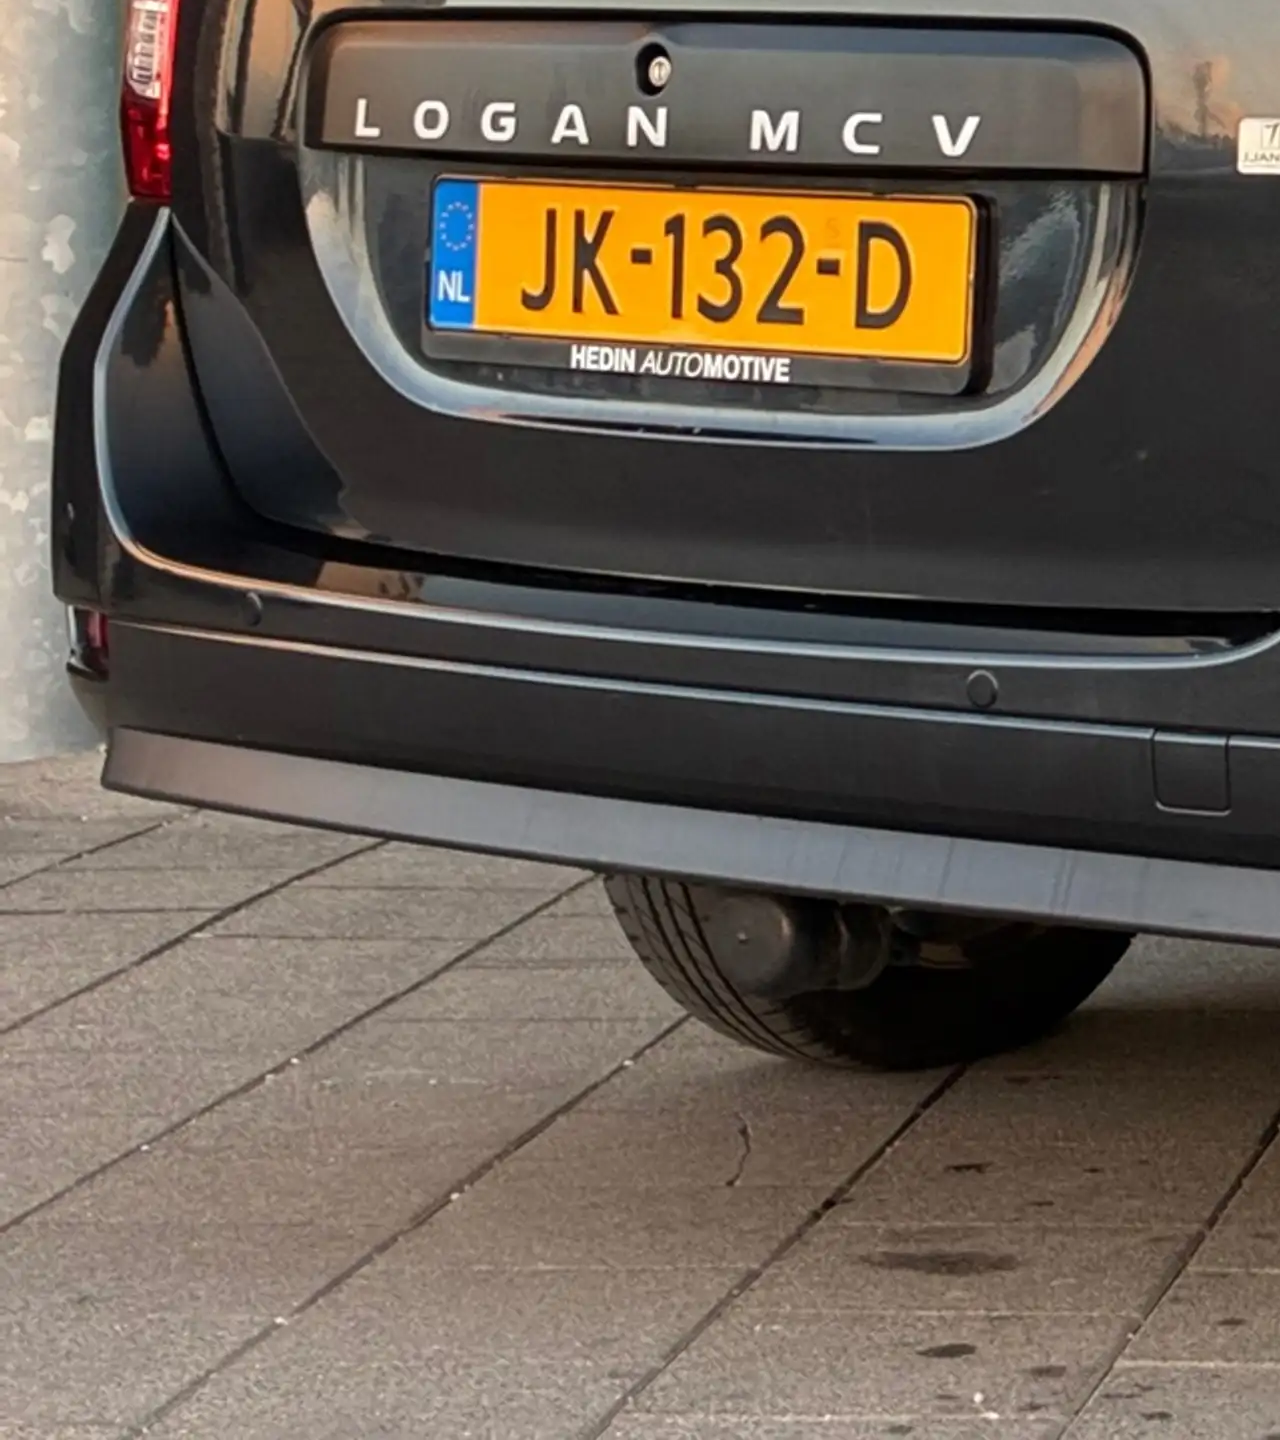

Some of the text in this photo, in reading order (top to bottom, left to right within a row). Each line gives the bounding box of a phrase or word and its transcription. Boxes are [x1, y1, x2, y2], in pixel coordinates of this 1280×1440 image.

[354, 98, 981, 157] LOGAN MCV
[437, 269, 471, 303] NL
[520, 207, 913, 330] JK-132-D
[570, 344, 792, 383] HEDIN AUTOMOTIVE
